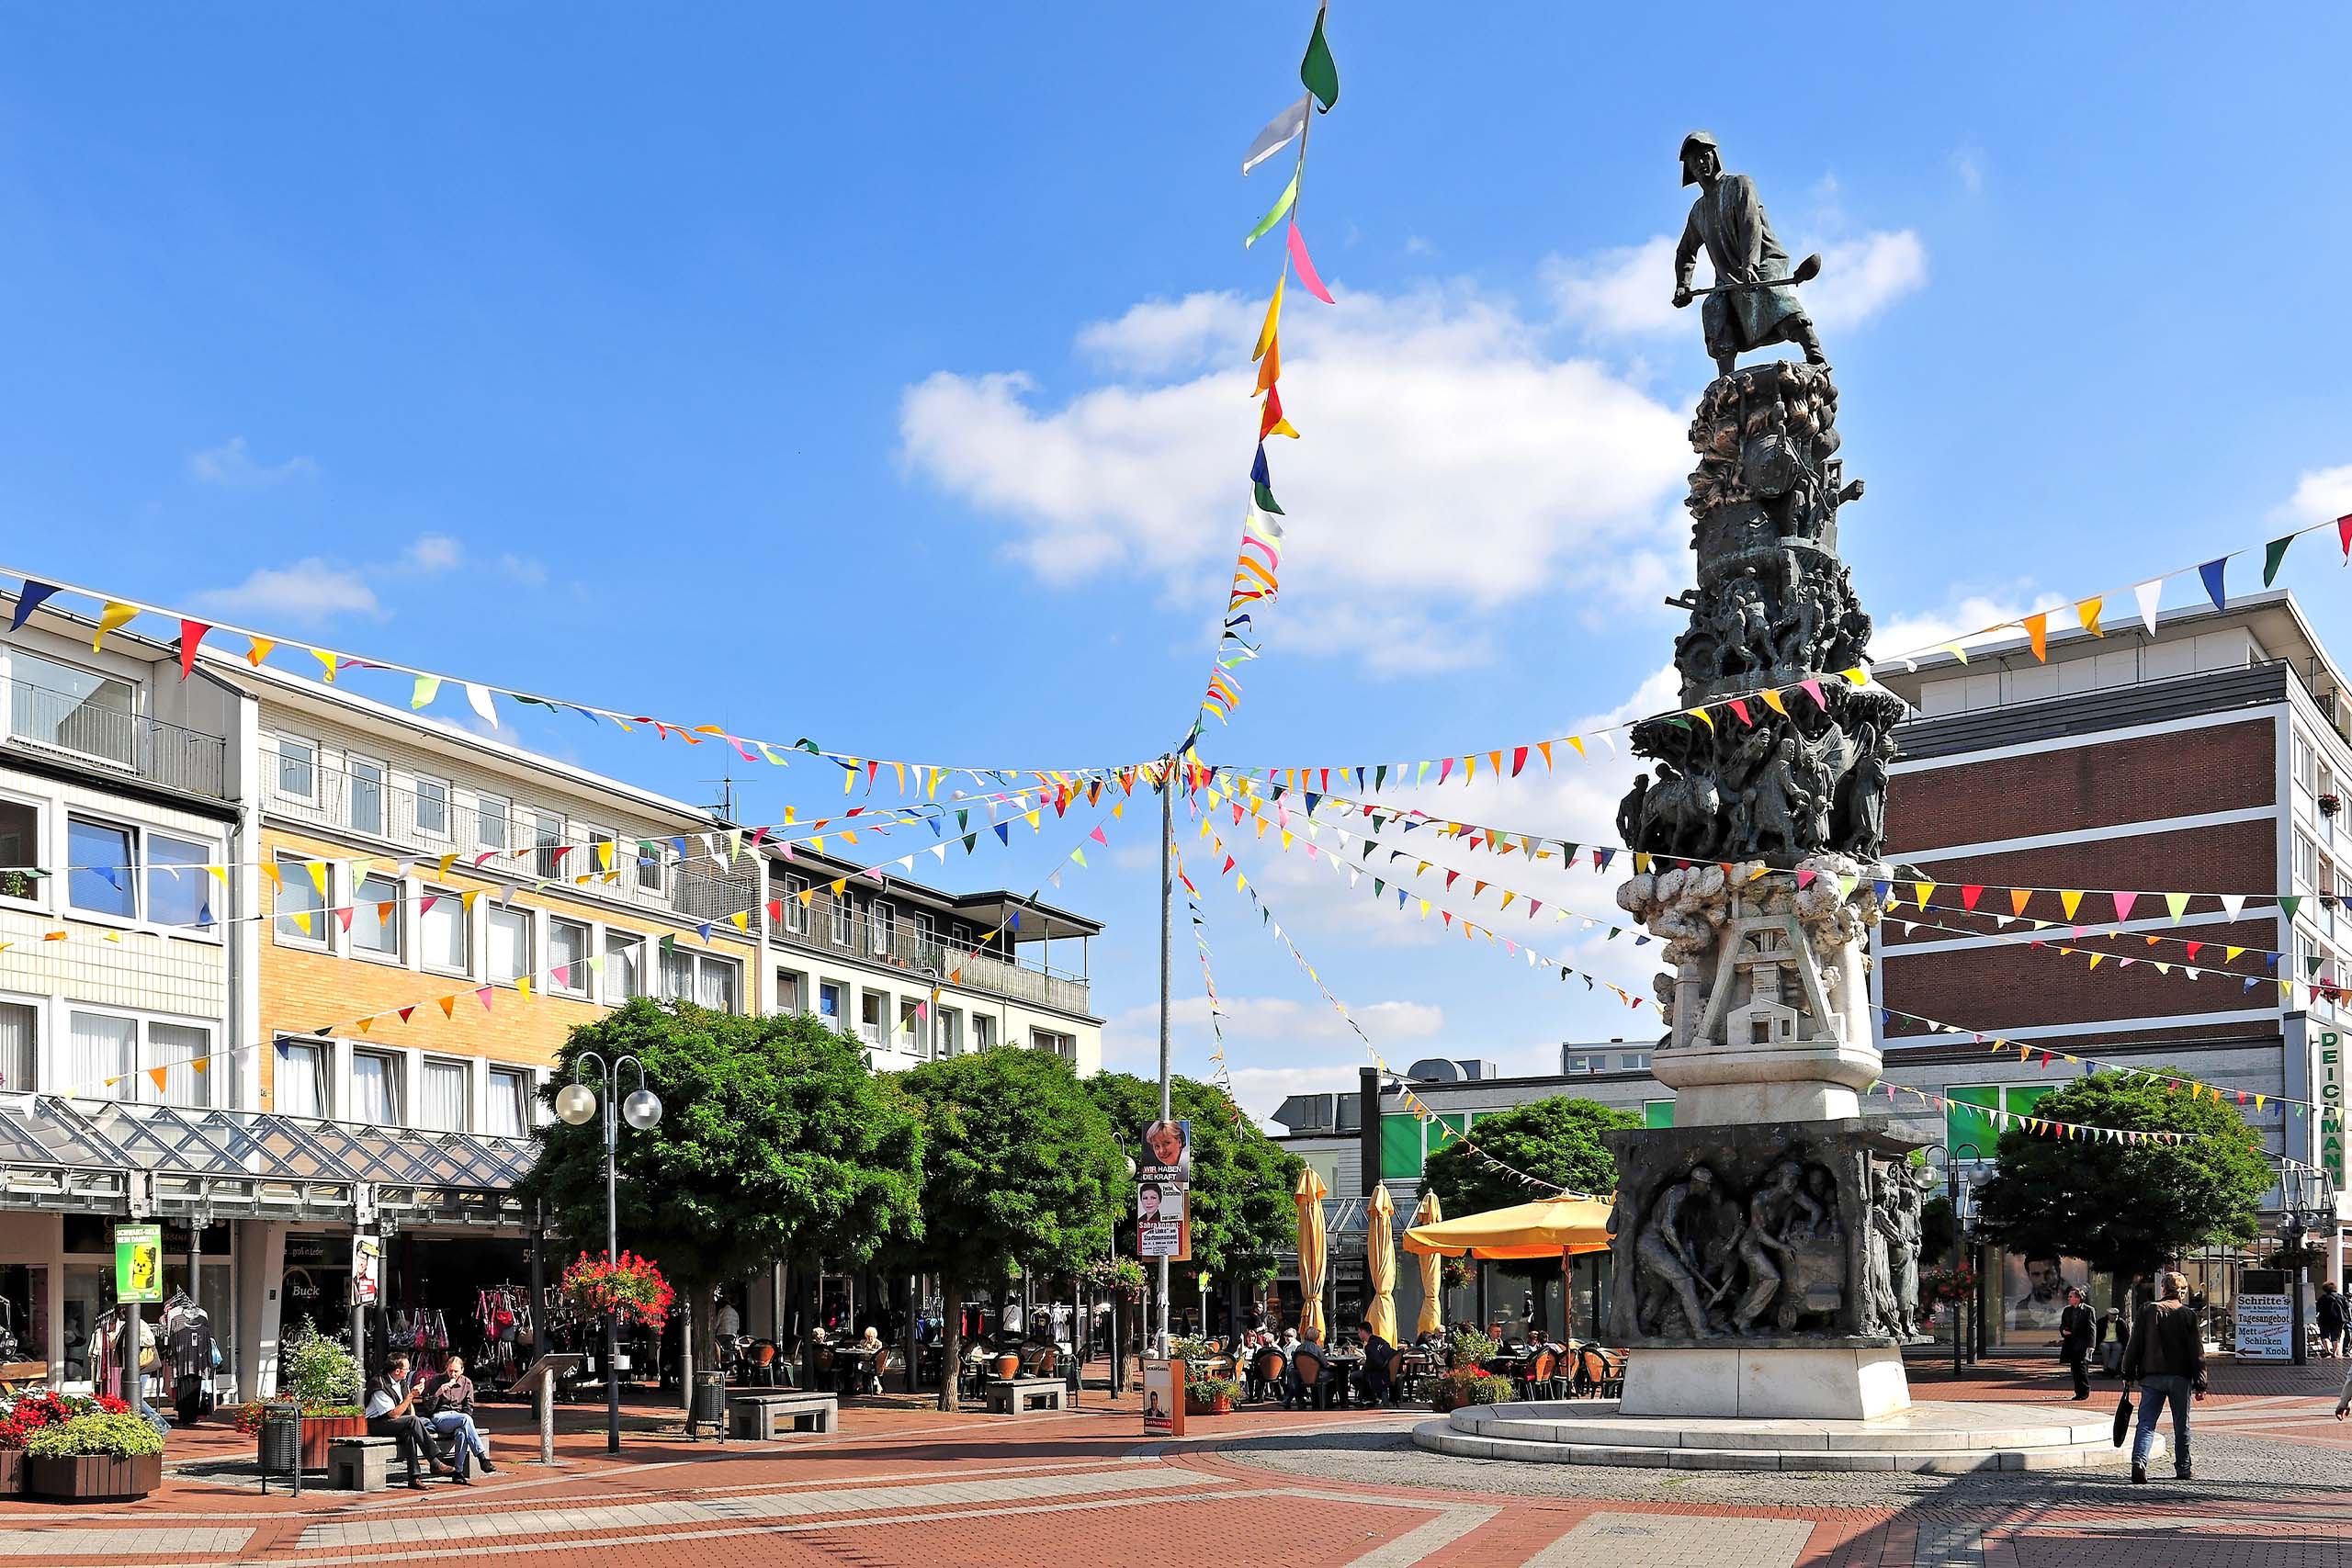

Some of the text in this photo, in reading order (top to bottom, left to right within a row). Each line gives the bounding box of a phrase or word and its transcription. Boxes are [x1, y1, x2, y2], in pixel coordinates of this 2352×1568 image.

[293, 1285, 321, 1296] Buck
[2238, 1314, 2290, 1325] Tagesangebot
[2238, 1327, 2257, 1336] Mett
[2245, 1337, 2282, 1346] Schinken
[2265, 1347, 2290, 1356] Knobi
